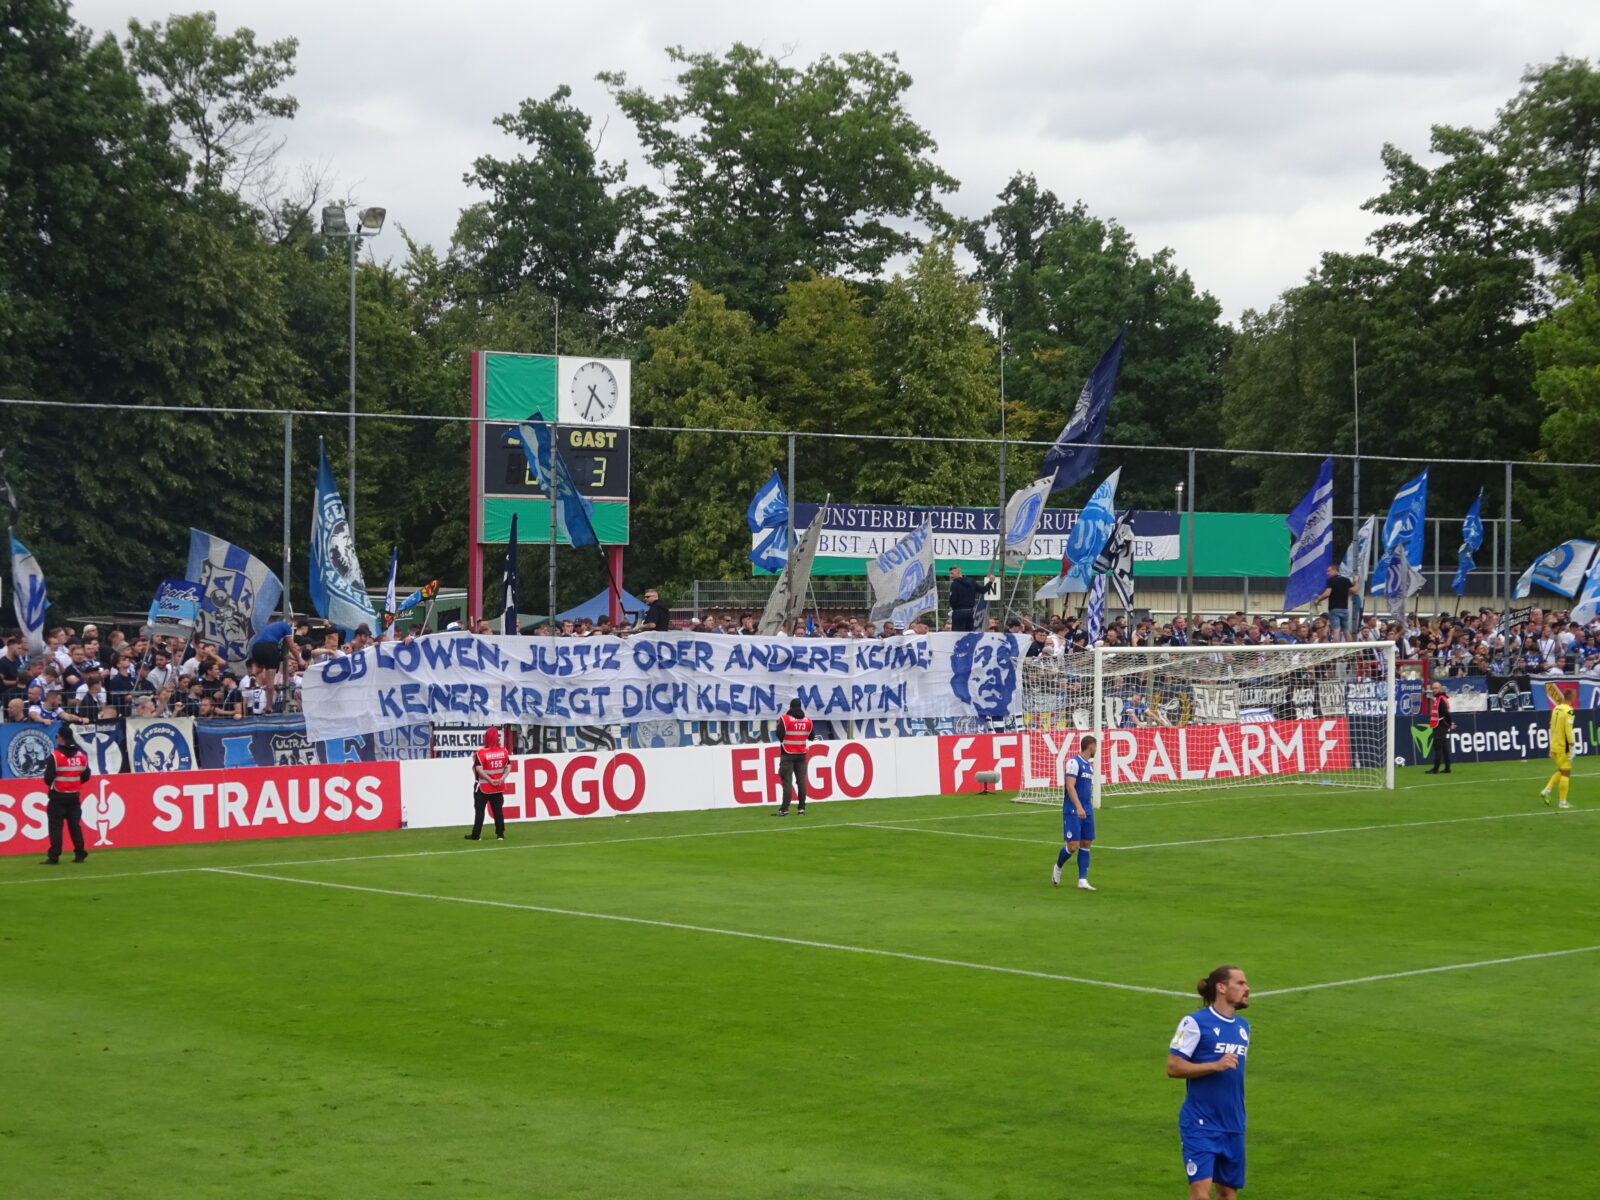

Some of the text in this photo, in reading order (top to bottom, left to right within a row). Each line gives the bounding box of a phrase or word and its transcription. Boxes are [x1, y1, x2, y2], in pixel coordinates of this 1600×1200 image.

[570, 431, 617, 448] GAST
[591, 457, 606, 487] 3
[819, 506, 976, 530] UNSTERBLICHER
[819, 535, 862, 553] BIST
[933, 538, 973, 556] UND
[322, 650, 367, 683] OB
[520, 643, 620, 676] JUSTIZ
[633, 640, 714, 672] ODER
[724, 643, 849, 673] ANDERE
[623, 682, 689, 717] DICH
[697, 683, 782, 715] KLEIN,
[797, 680, 908, 715] MARTIN!
[380, 724, 430, 747] UNS
[794, 722, 807, 731] 173
[1446, 725, 1526, 758] reenet,
[67, 757, 81, 767] 135
[380, 747, 429, 760] NICHT
[490, 760, 503, 769] 155
[731, 742, 873, 804] ERGO
[152, 776, 383, 832] STRAUSS
